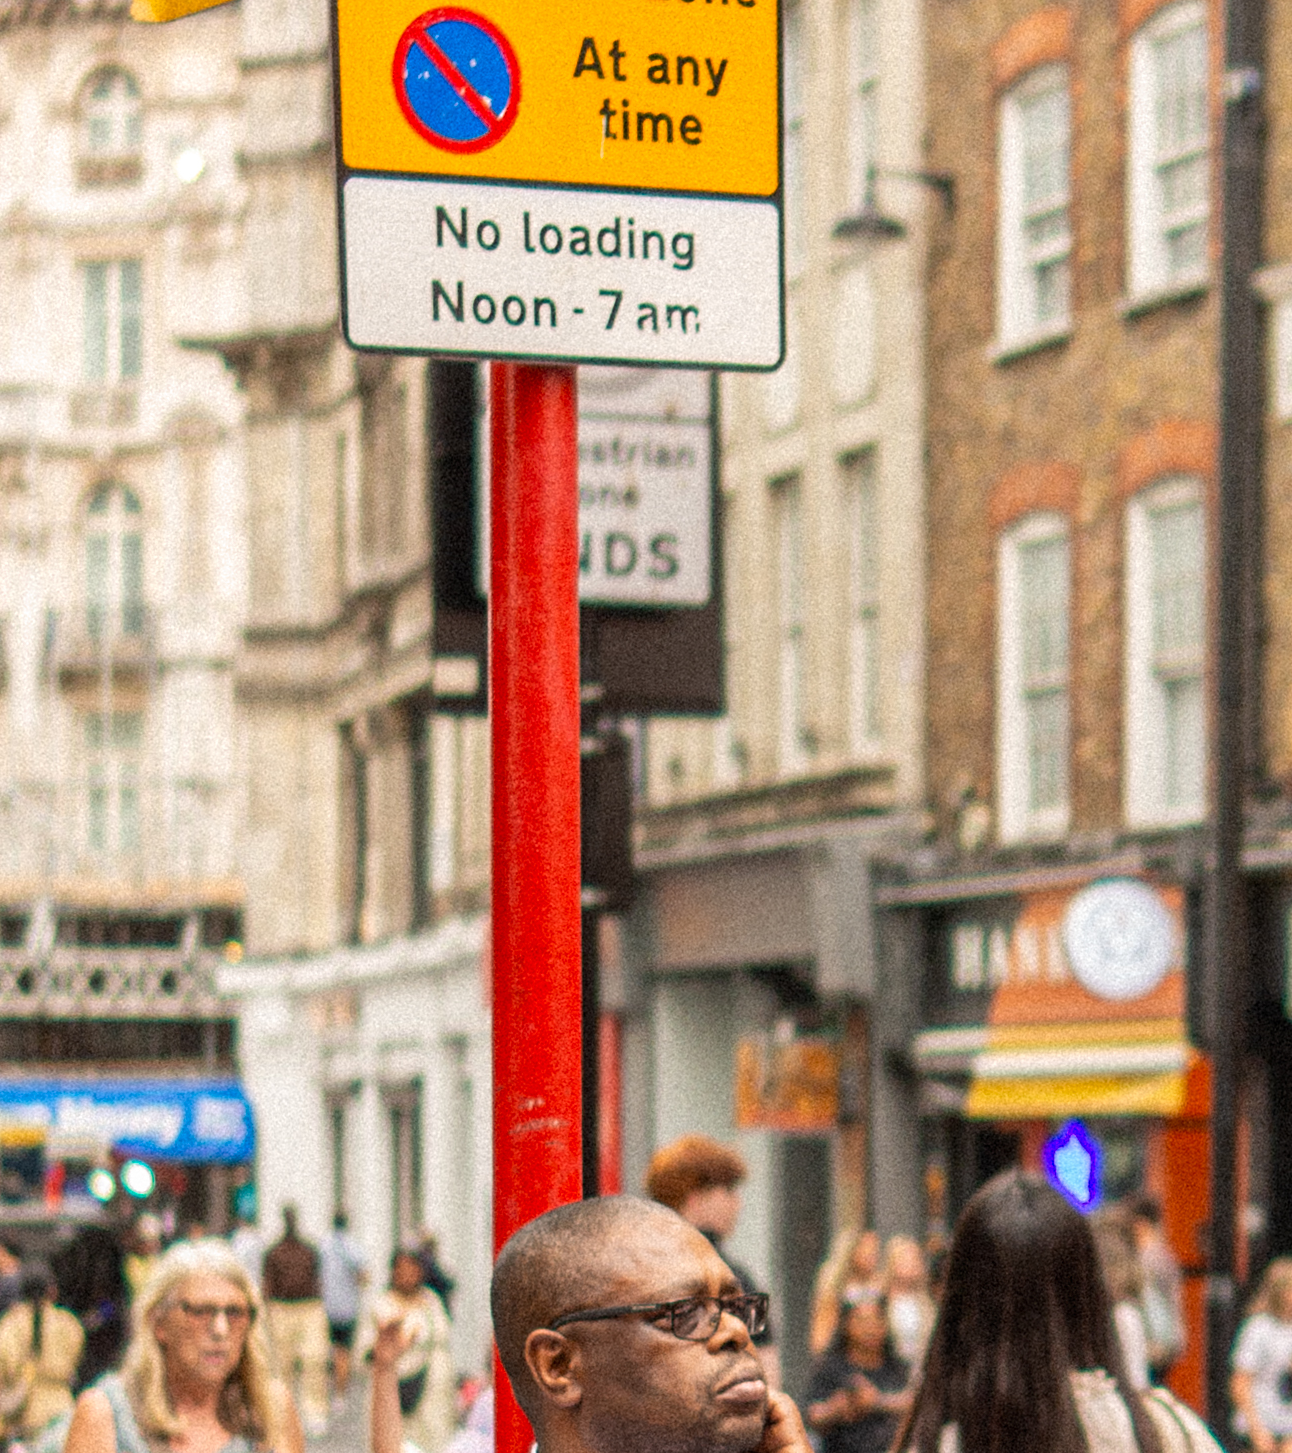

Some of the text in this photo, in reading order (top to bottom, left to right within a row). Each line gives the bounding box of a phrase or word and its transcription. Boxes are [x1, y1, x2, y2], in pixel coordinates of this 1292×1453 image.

[573, 36, 728, 97] At any
[599, 98, 703, 145] time
[435, 206, 694, 270] No loading
[431, 279, 557, 327] Noon
